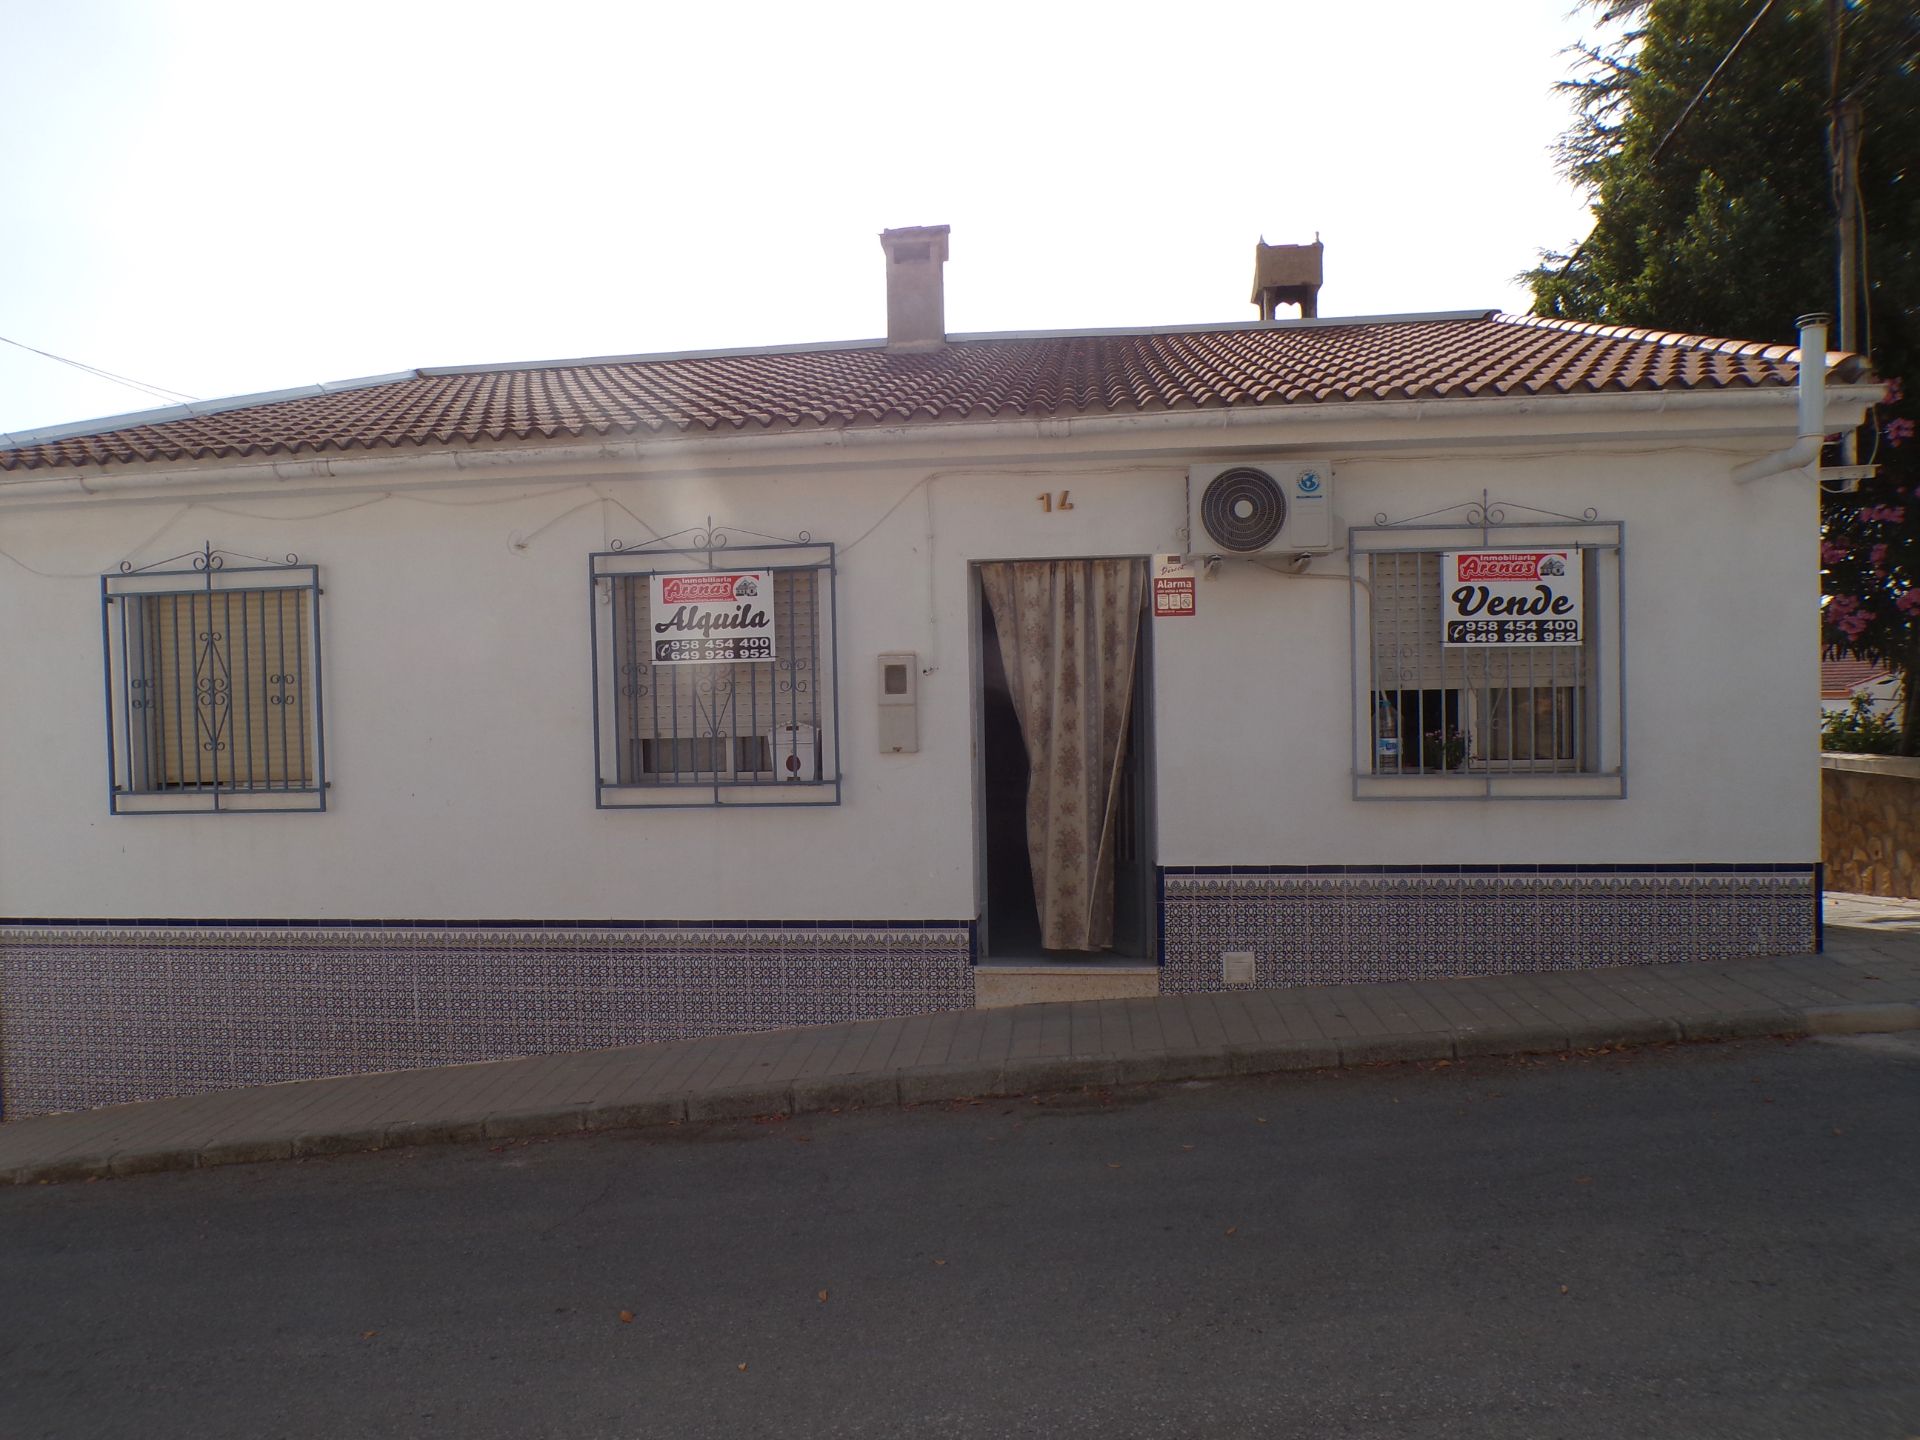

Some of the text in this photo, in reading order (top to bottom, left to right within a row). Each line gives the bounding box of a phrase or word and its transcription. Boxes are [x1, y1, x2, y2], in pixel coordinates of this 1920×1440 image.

[1460, 557, 1535, 579] Arenas
[664, 580, 731, 601] Arenas
[1157, 580, 1192, 589] Alarma
[1451, 585, 1575, 616] Vende
[655, 604, 770, 638] Alquila
[1465, 621, 1577, 631] 958 454 400
[1465, 632, 1577, 642] 649 926 952
[671, 638, 769, 650] 958 454 400
[671, 649, 770, 660] 649 926 952
